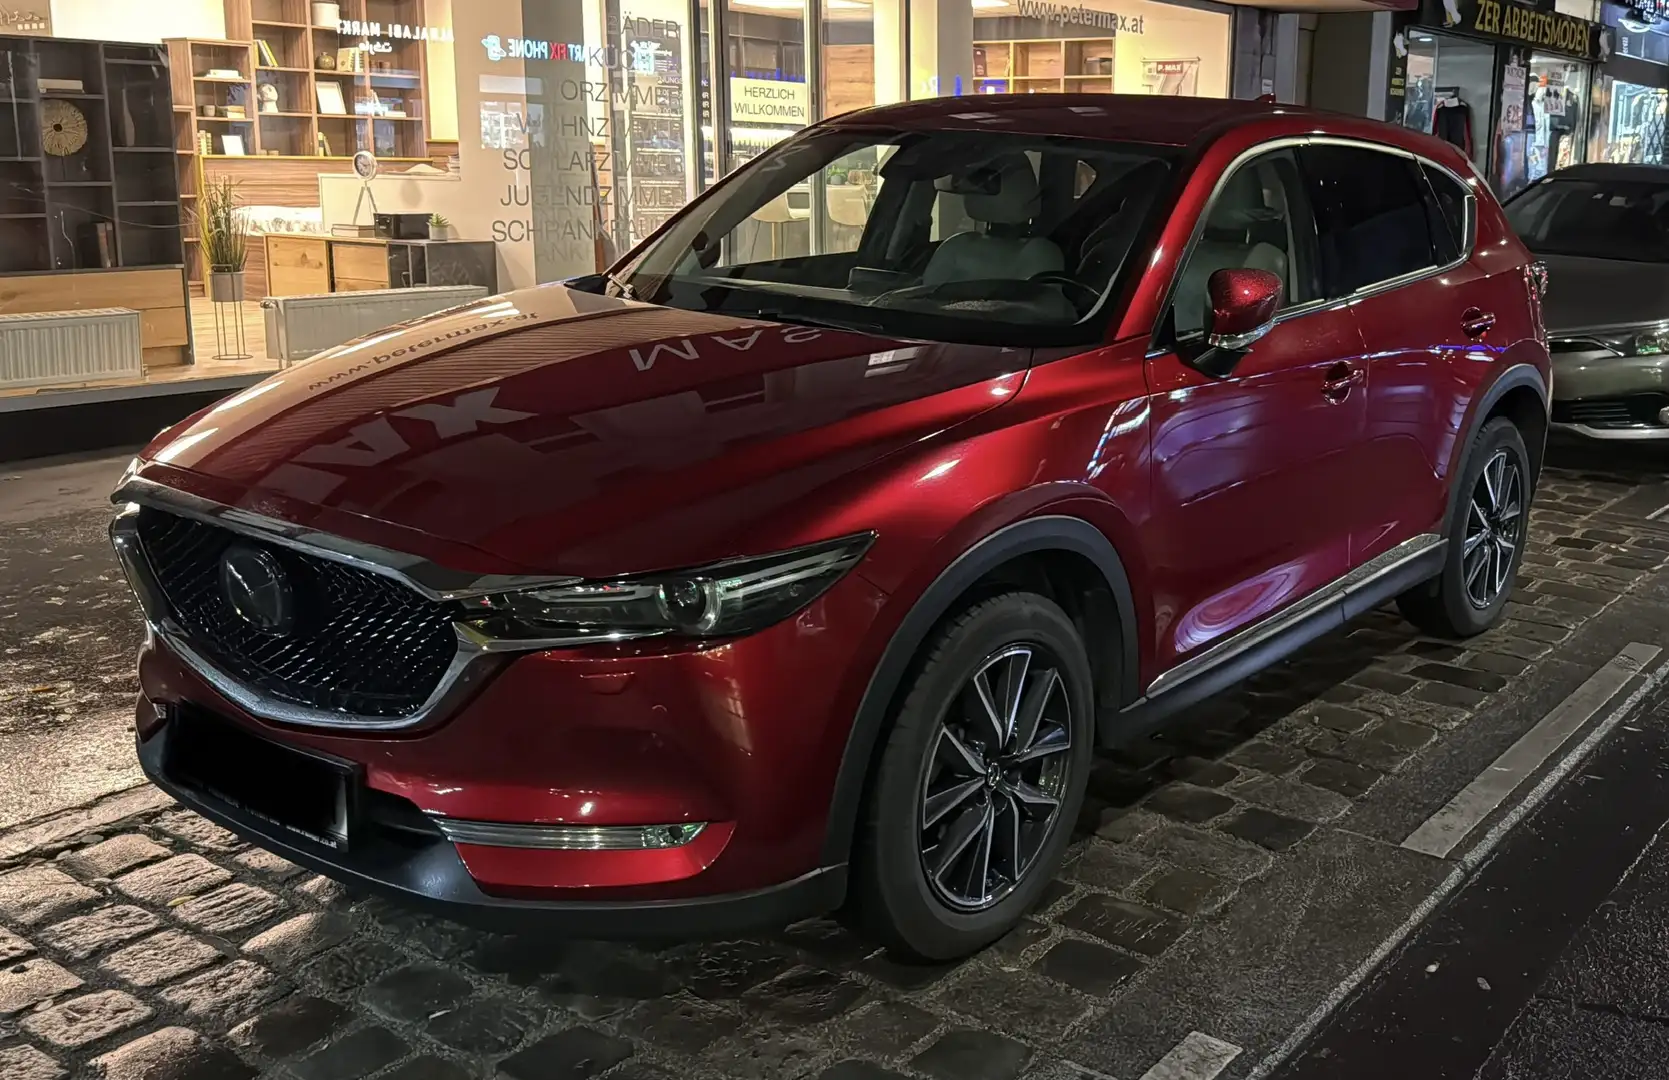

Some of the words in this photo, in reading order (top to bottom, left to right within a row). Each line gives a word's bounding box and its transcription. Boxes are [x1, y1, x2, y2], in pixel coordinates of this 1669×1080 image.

[1017, 0, 1144, 34] www.petermax.at
[1502, 5, 1590, 54] ARBEITSMODEN
[744, 86, 795, 100] HERZLICH
[734, 102, 805, 117] WILLKOMMEN
